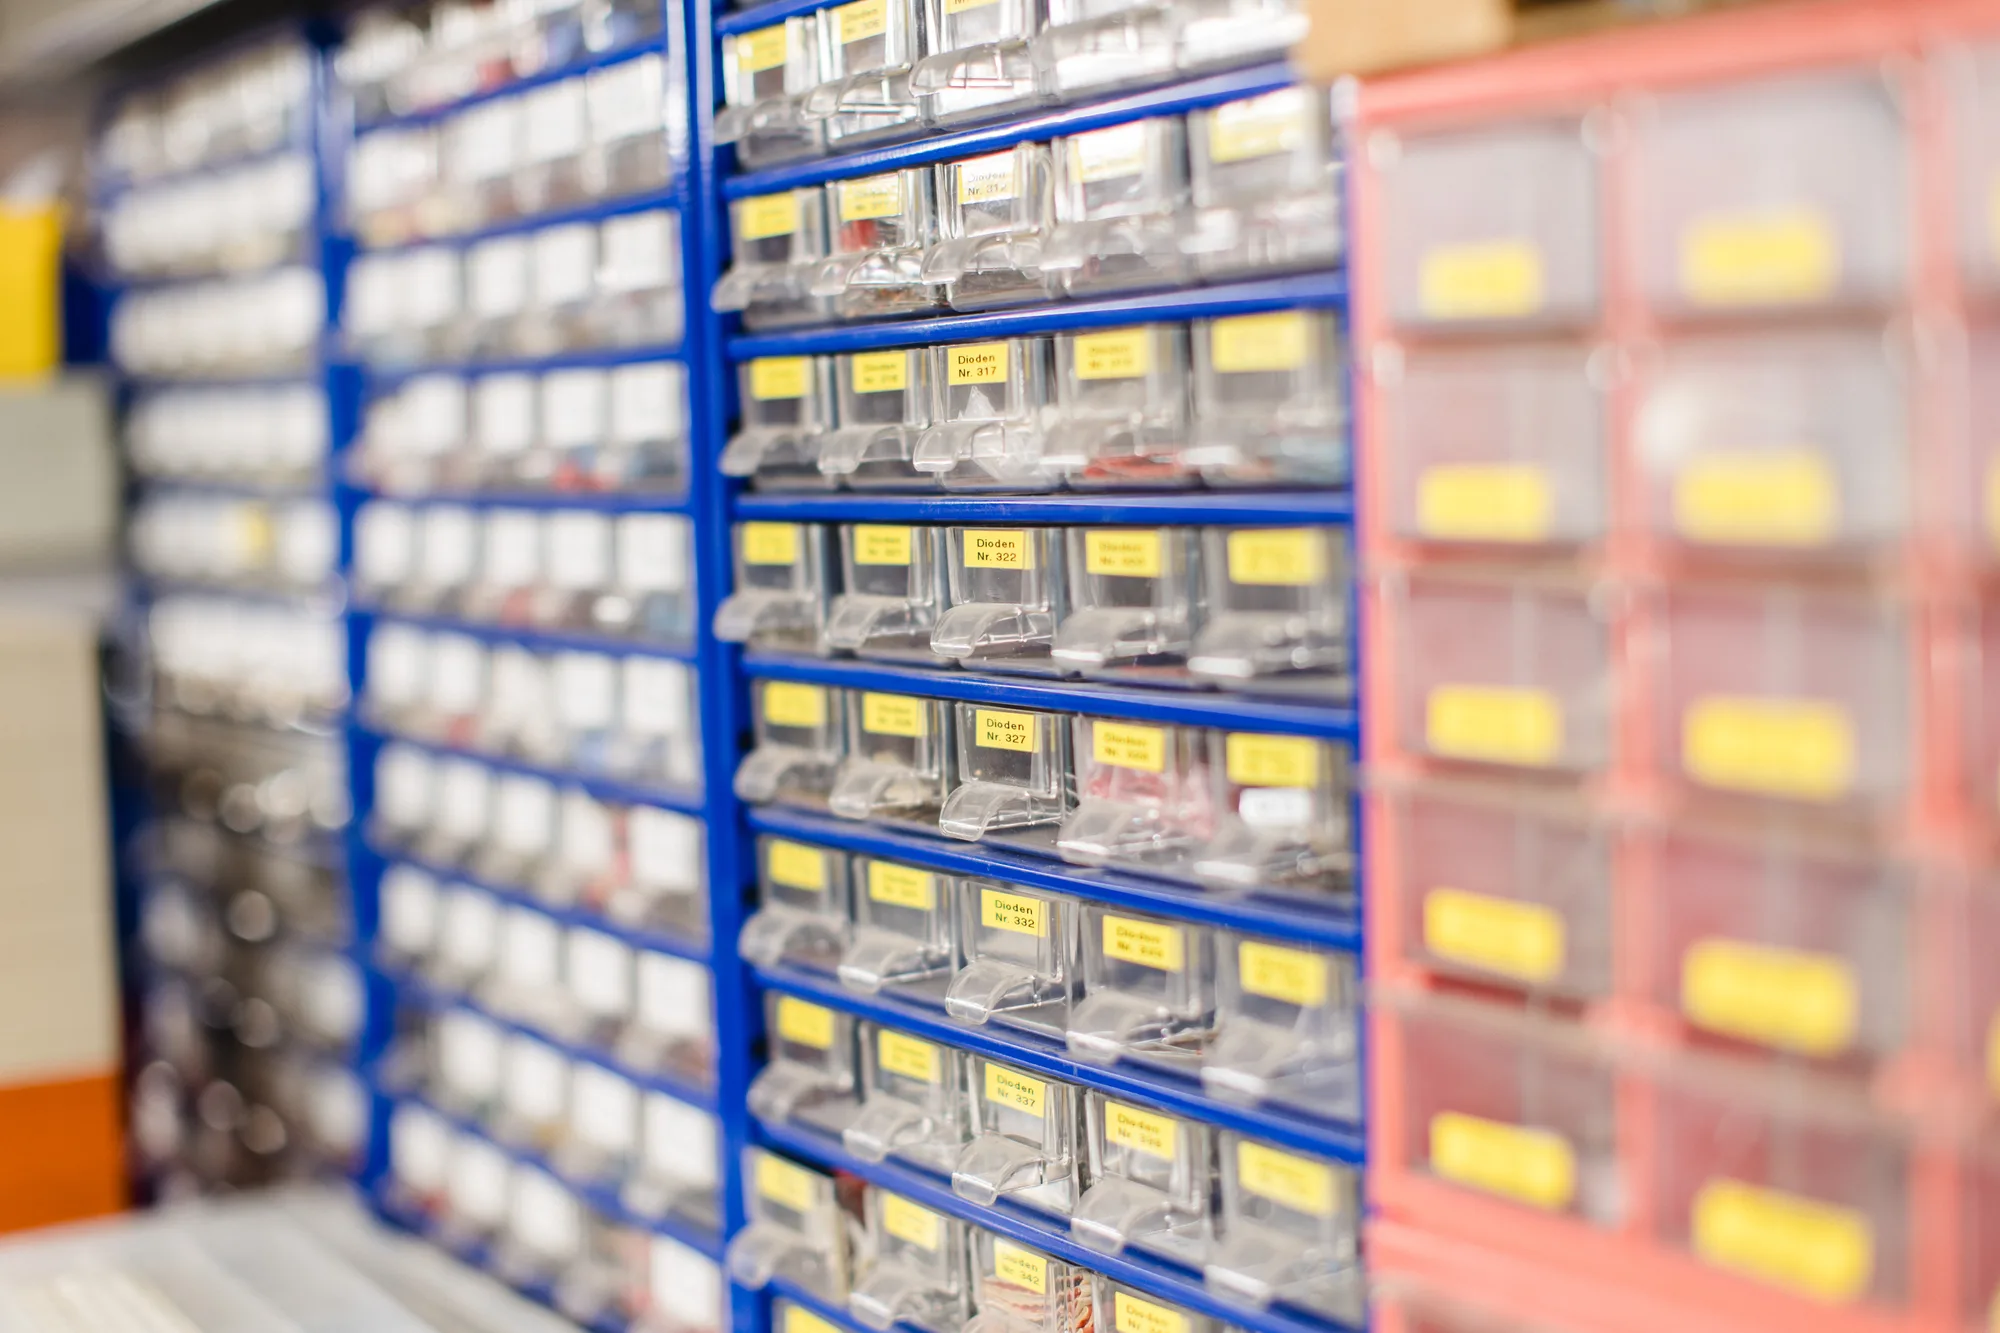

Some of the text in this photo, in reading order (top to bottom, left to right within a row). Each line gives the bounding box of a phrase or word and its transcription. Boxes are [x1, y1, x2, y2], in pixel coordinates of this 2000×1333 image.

[986, 183, 1007, 194] 312
[957, 353, 996, 365] Dioden
[958, 366, 997, 379] Nr. 317
[976, 538, 1015, 549] Dioden
[977, 552, 1017, 562] Nr. 322
[986, 719, 1025, 731] Dioden
[987, 732, 1026, 744] Nr. 327
[994, 899, 1033, 915] Dioden
[995, 912, 1035, 929] Nr. 332
[996, 1074, 1035, 1095] Dioden
[1015, 1094, 1036, 1107] 337
[1019, 1269, 1040, 1286] 342
